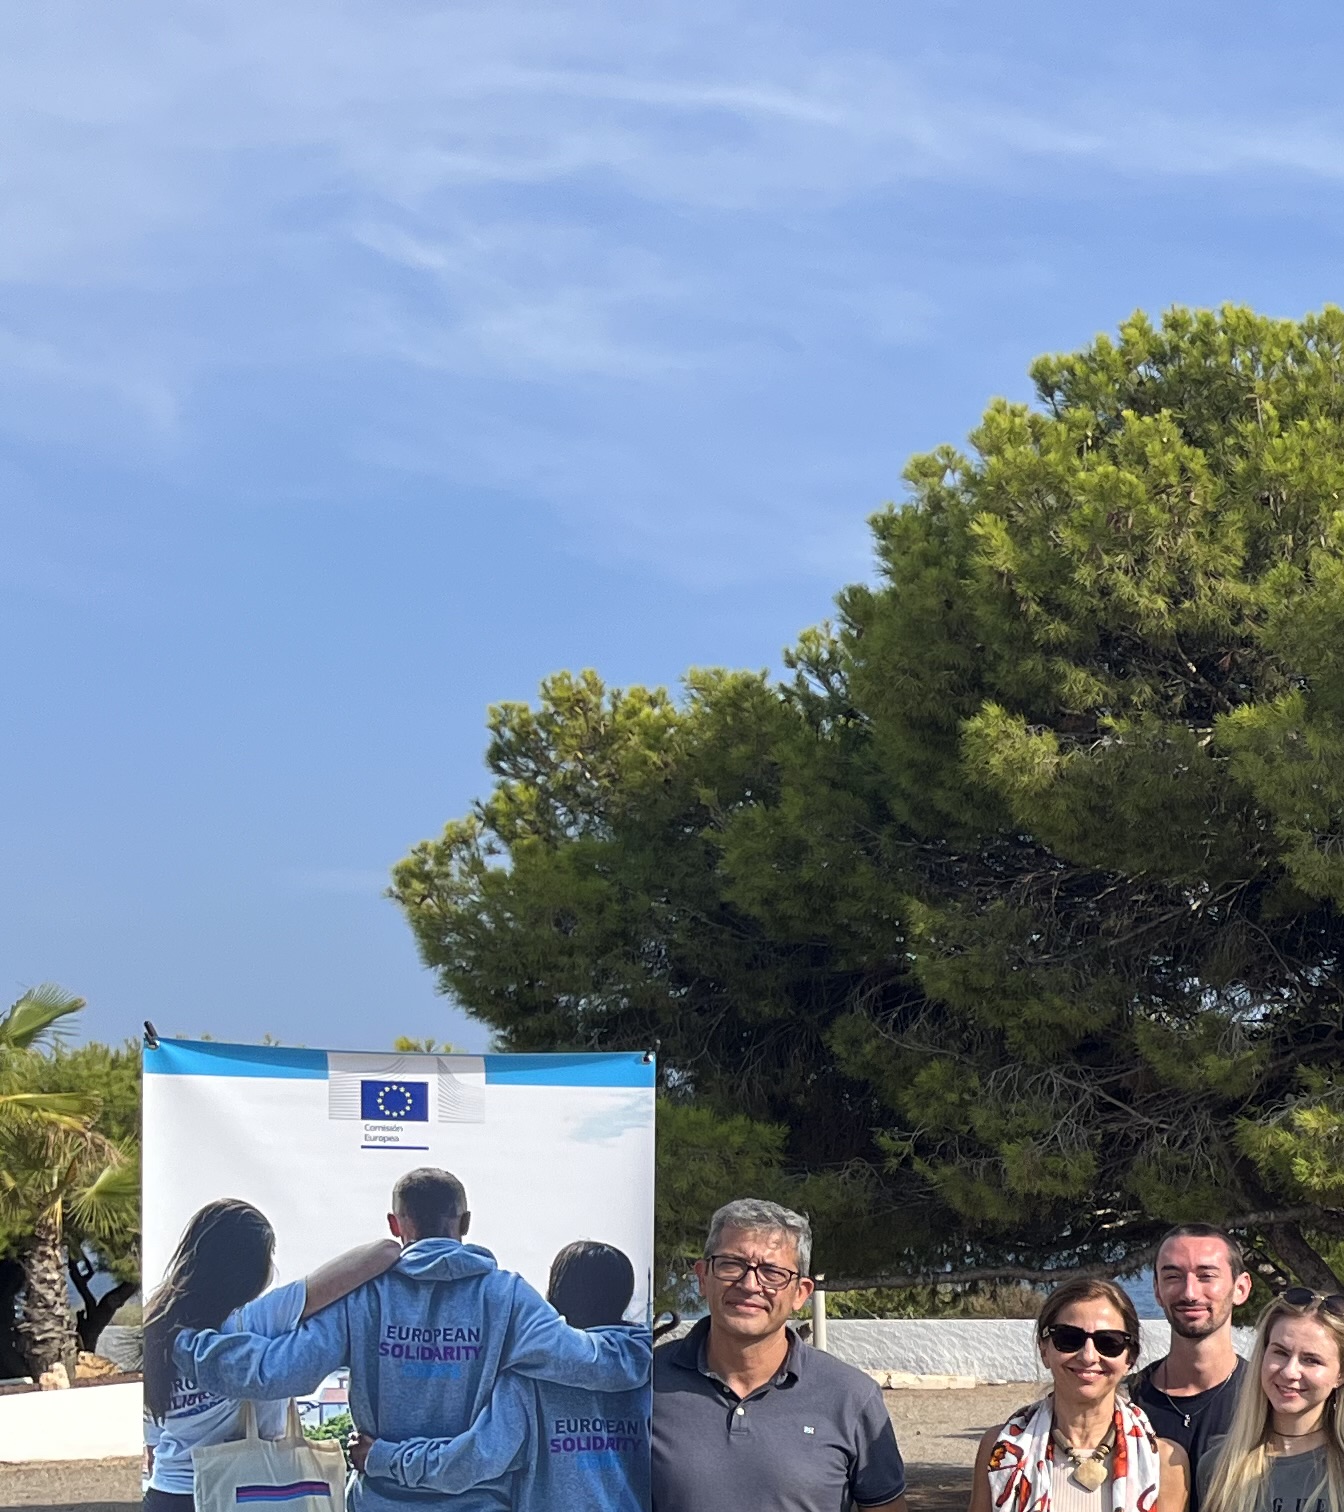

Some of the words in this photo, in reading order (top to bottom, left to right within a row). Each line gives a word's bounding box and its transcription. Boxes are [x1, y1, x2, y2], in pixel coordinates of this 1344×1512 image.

[363, 1134, 400, 1143] Europea
[386, 1325, 480, 1343] EUROPEAN
[379, 1342, 483, 1361] SOLIDARITY
